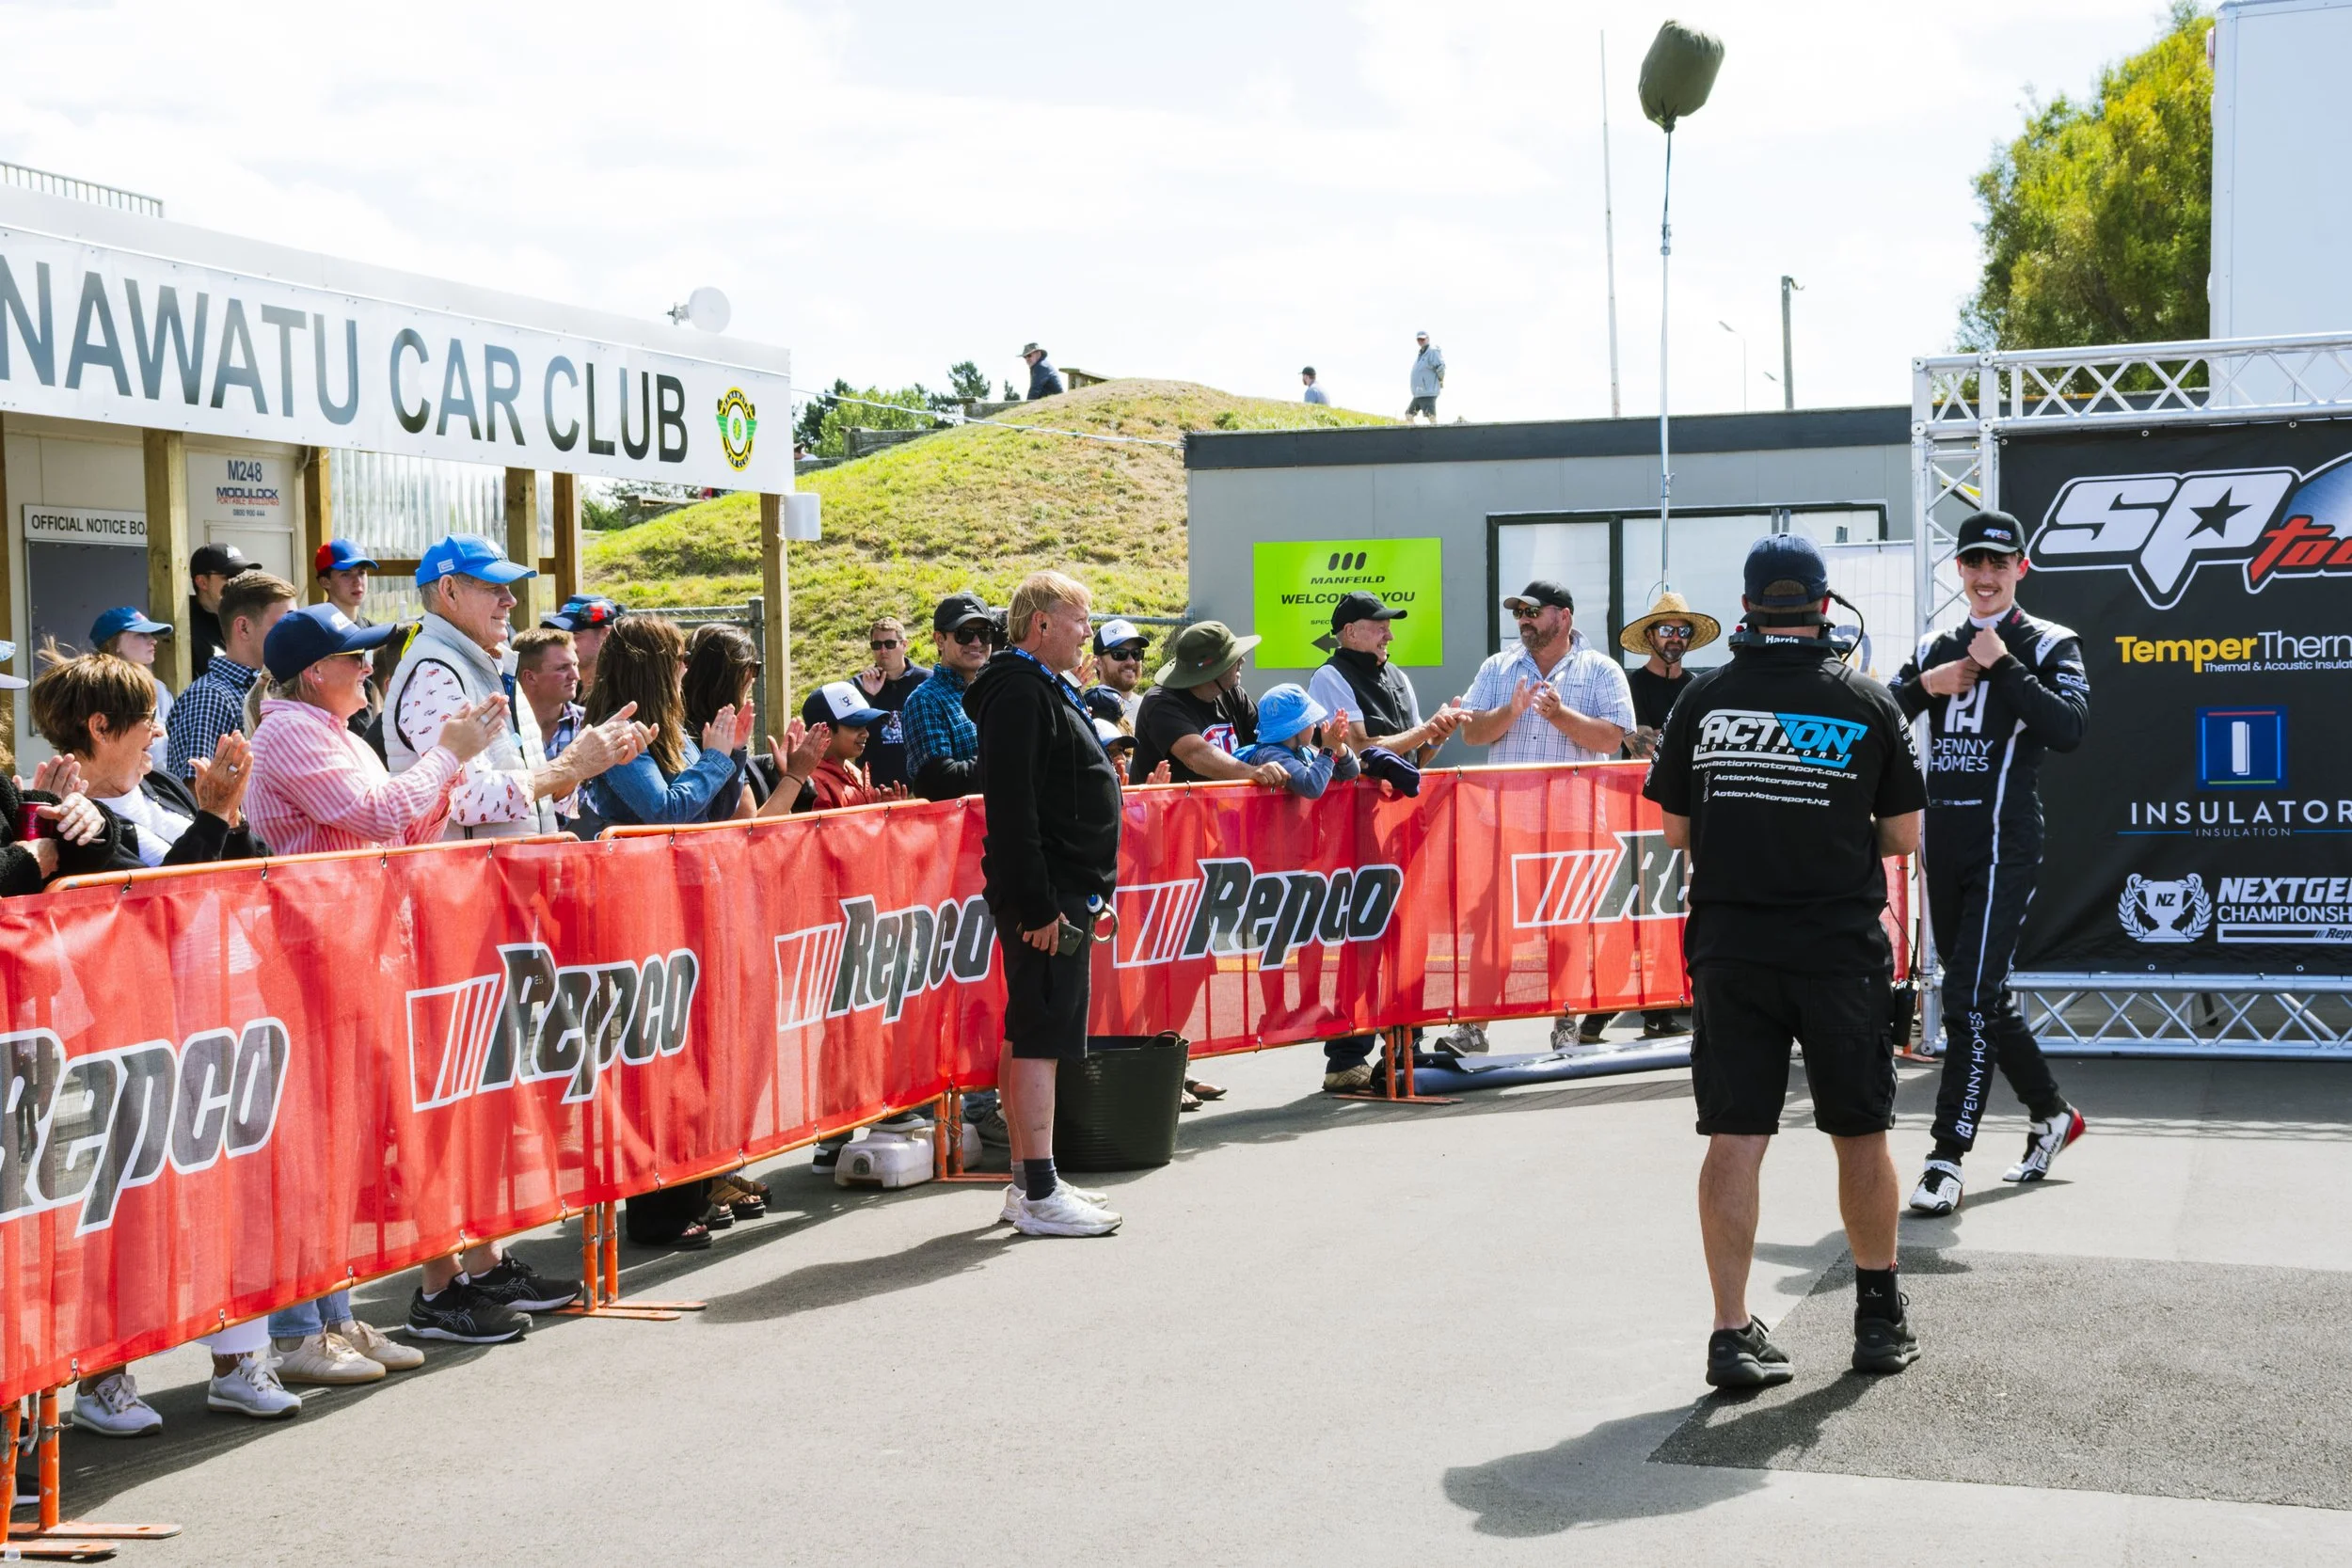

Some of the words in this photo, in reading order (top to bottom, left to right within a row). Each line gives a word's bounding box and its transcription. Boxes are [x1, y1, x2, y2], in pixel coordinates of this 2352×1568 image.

[0, 255, 359, 425] NAWATU
[389, 327, 526, 446] CAR
[544, 356, 689, 464] CLUB
[228, 460, 262, 483] M248
[216, 487, 278, 500] MODULOCK
[31, 515, 84, 532] OFFICIAL
[87, 518, 127, 534] NOTICE
[130, 521, 148, 535] BO
[1310, 576, 1385, 585] MANFEILD
[1381, 592, 1416, 602] YOU
[2203, 662, 2250, 673] Thermal
[2252, 661, 2262, 672] &
[2264, 660, 2313, 671] Acoustic
[1700, 716, 1859, 755] ACTION
[1932, 737, 1994, 755] PENNY
[1699, 743, 1844, 761] MOTORSPORT
[1930, 755, 1990, 771] HOMES
[1713, 773, 1829, 790] ActionMotorsportNZ
[2131, 800, 2352, 825] INSULATOR
[2195, 828, 2291, 837] INSULATION
[2155, 893, 2176, 907] NZ
[2217, 878, 2352, 903] NEXTGE
[1179, 857, 1404, 971] Repco
[826, 895, 995, 1024] Repco
[476, 942, 700, 1103] Repco
[1968, 1011, 1987, 1063] HOMES
[1961, 1066, 1985, 1120] PENNY
[0, 1017, 290, 1238] Repco
